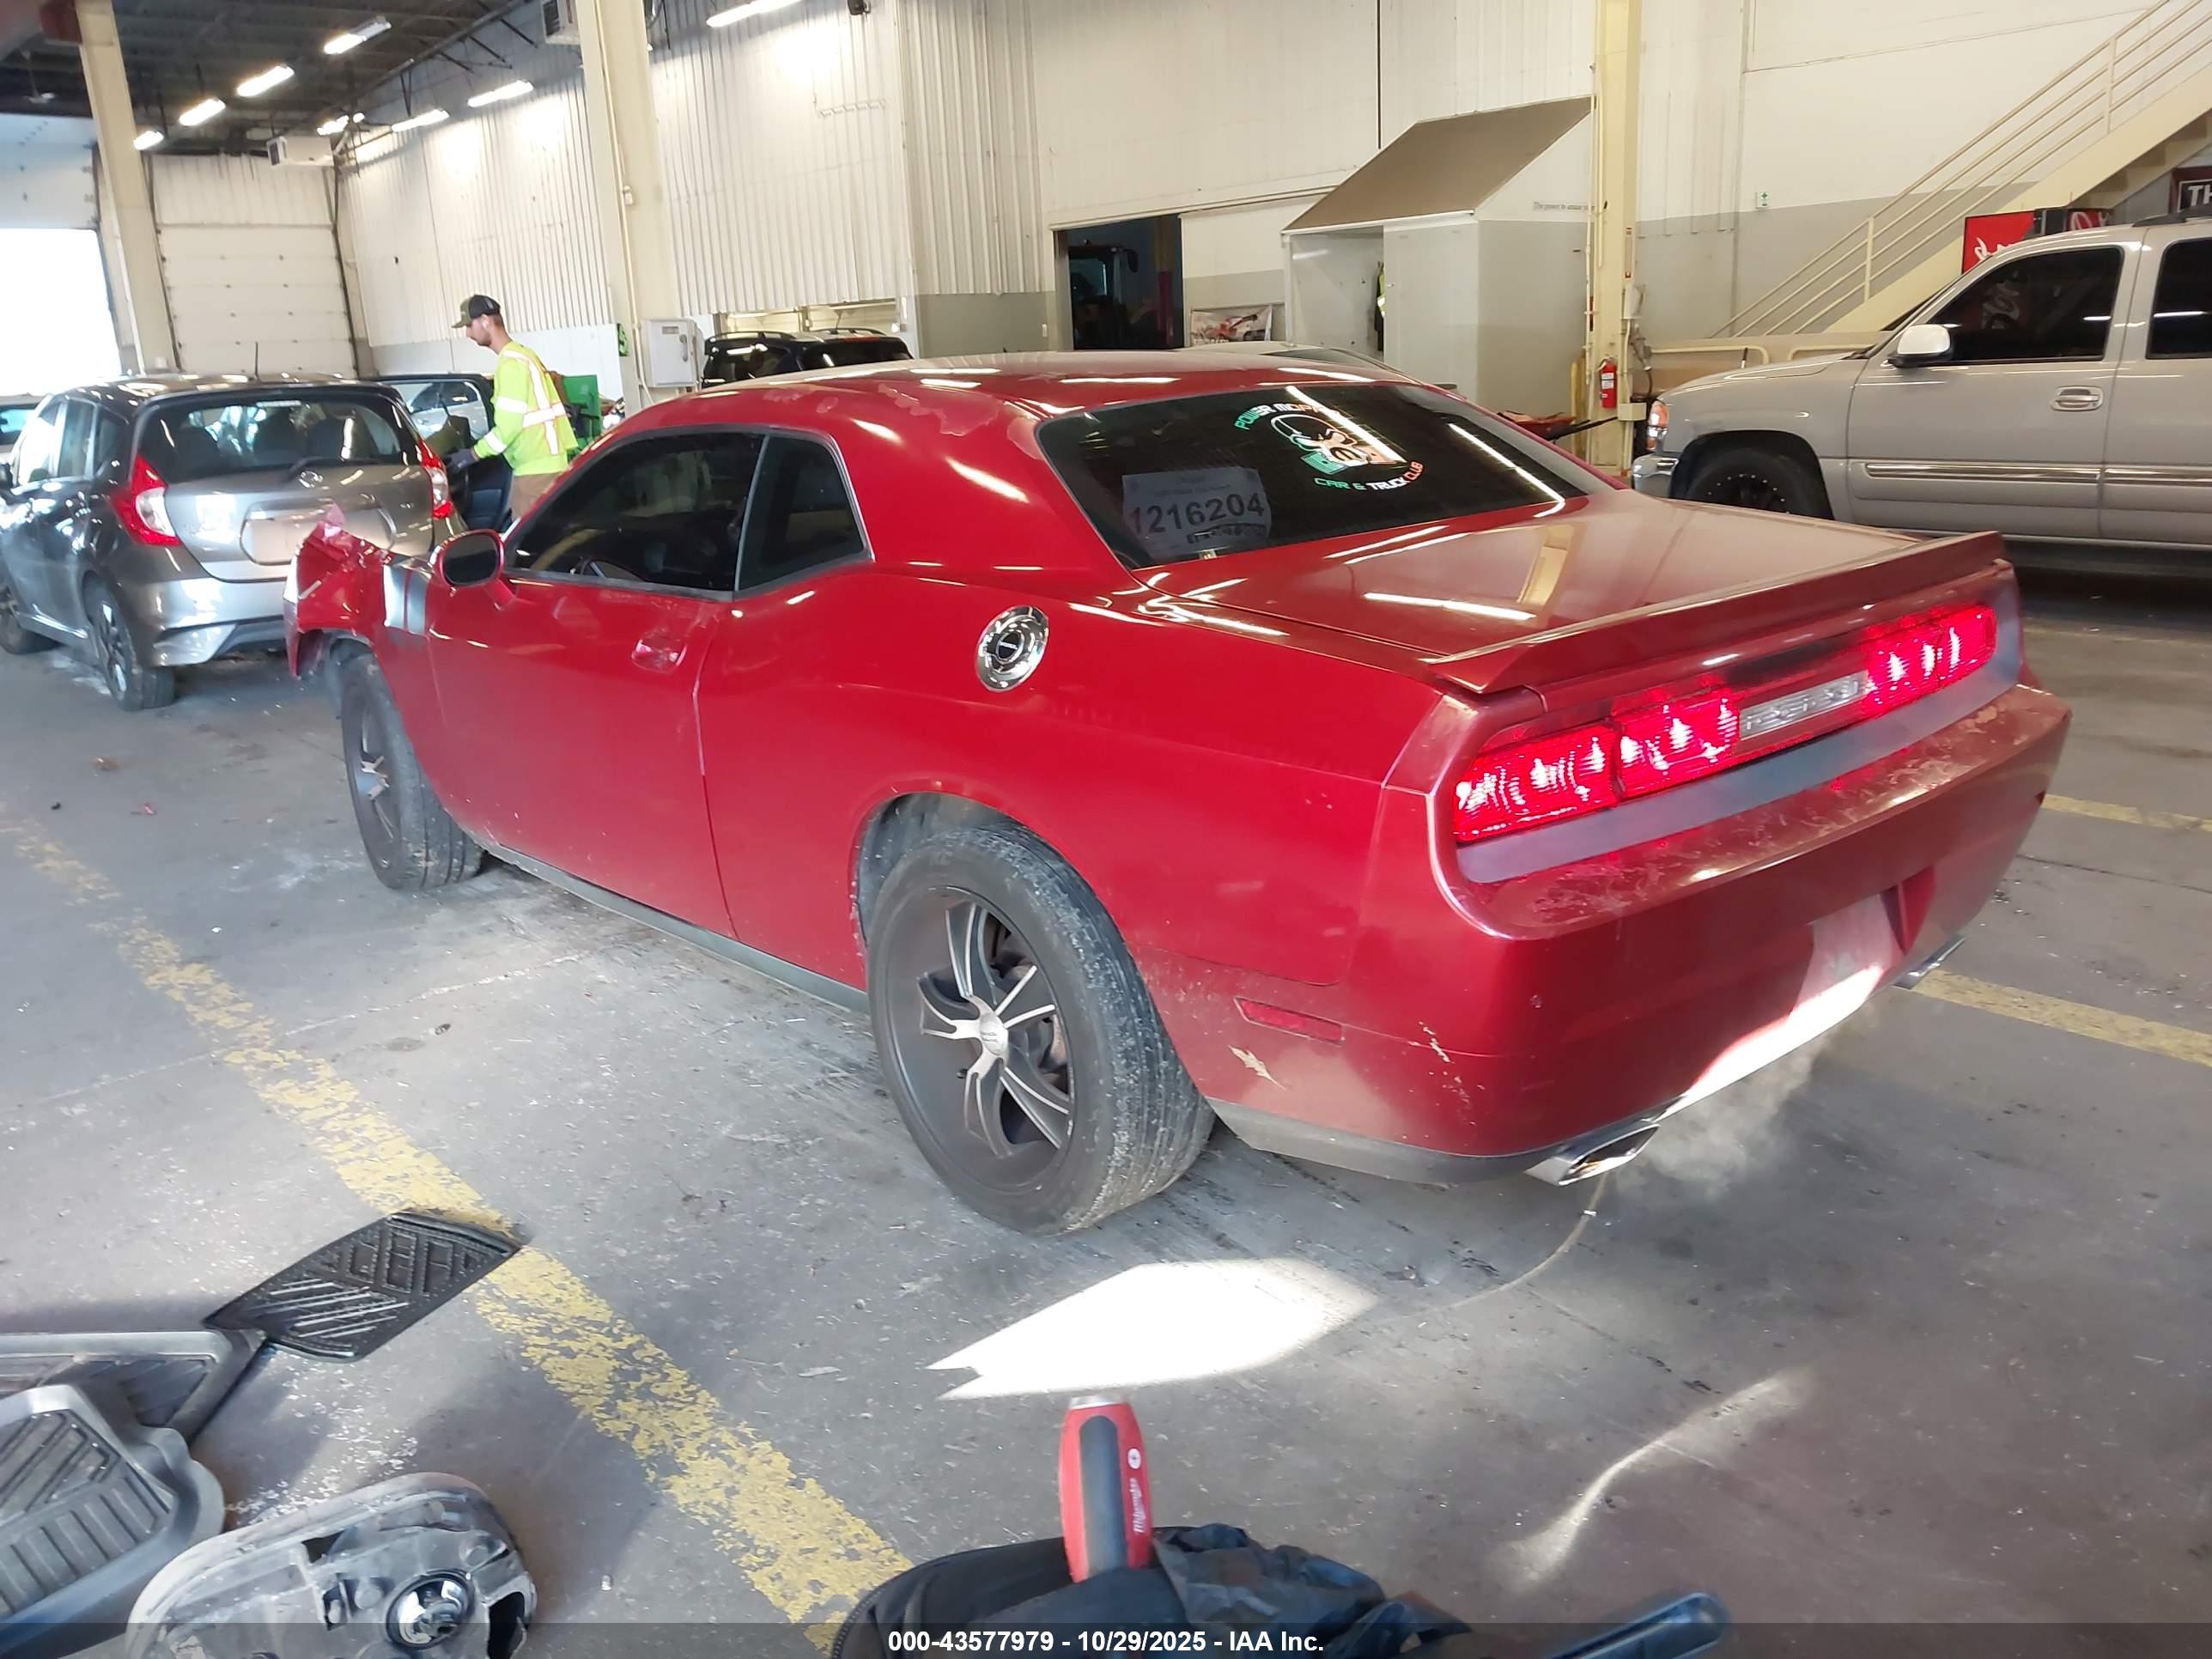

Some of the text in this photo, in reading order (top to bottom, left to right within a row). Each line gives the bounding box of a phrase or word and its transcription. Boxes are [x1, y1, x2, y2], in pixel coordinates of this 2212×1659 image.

[1235, 404, 1276, 430] POWER
[1314, 477, 1351, 489] CAR
[1365, 476, 1410, 490] TRUCK
[1403, 461, 1424, 481] CLUB
[1129, 493, 1265, 534] 1216204
